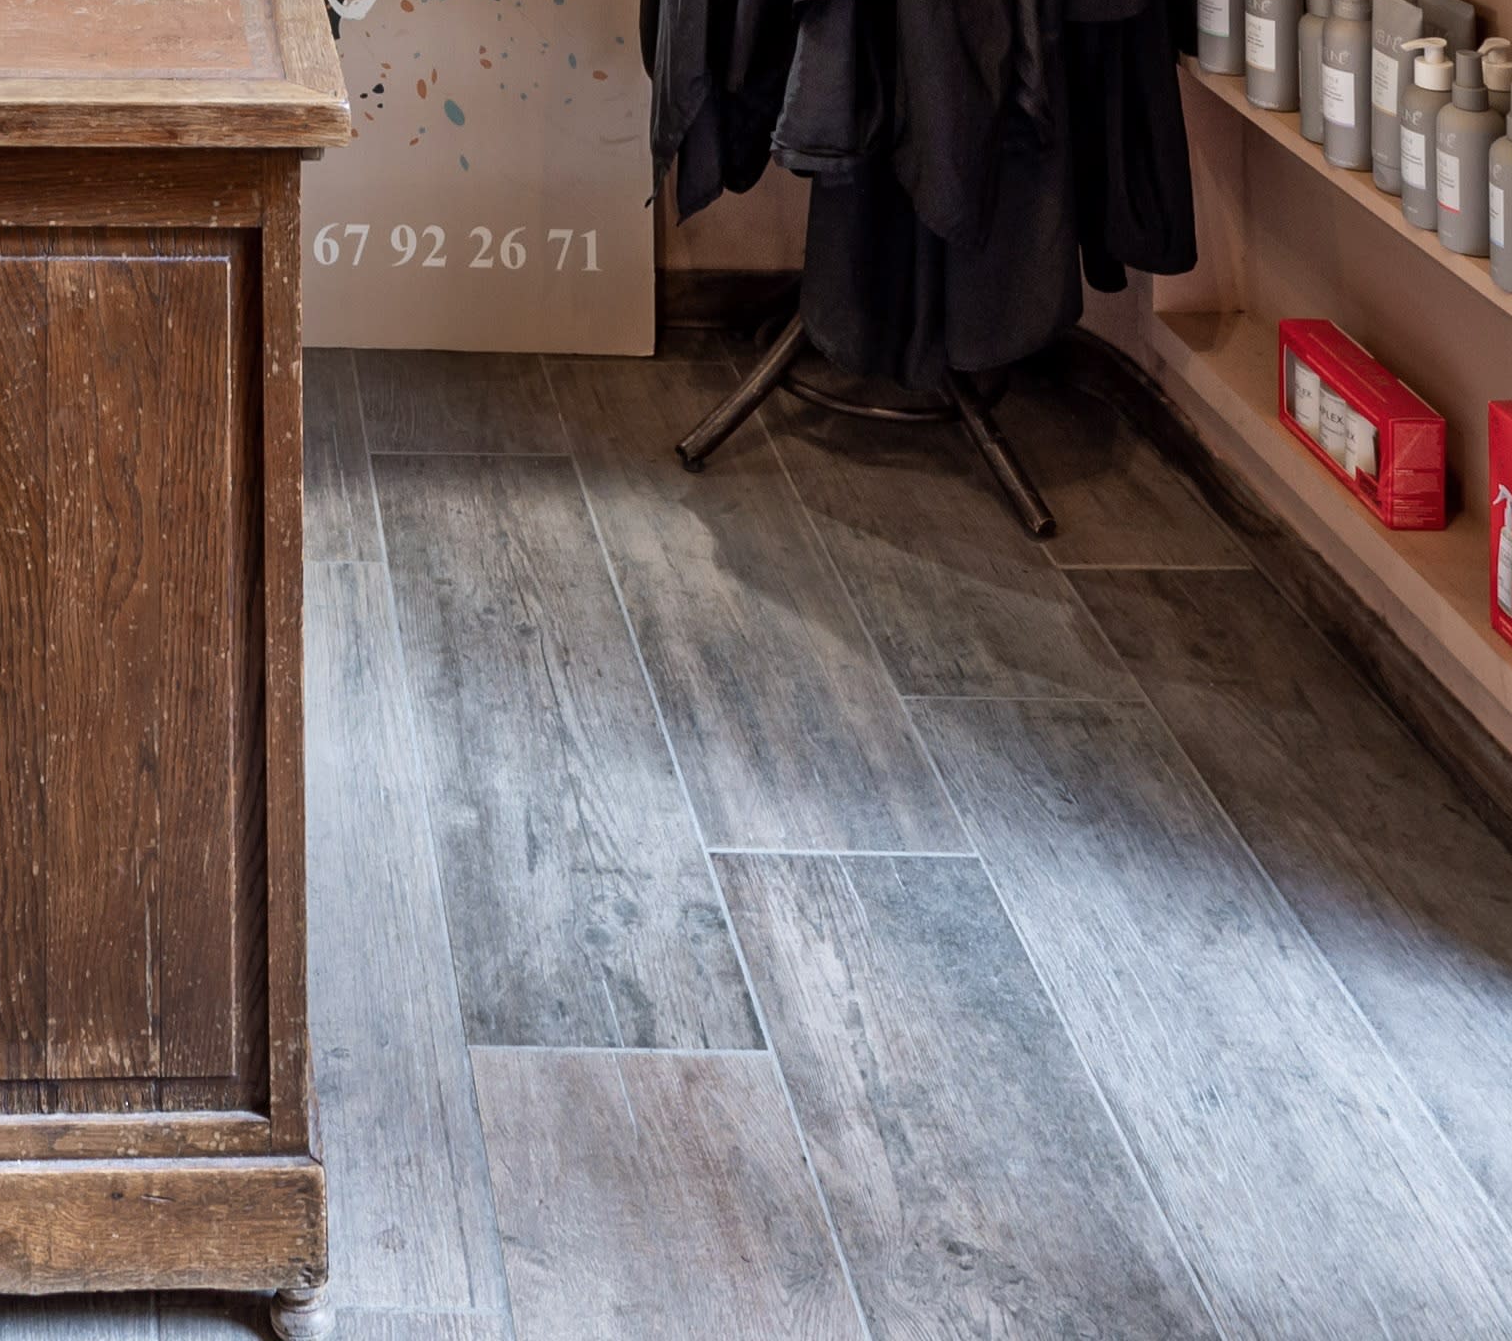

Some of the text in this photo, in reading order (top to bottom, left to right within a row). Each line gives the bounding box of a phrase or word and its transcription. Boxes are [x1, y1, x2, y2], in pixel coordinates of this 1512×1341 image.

[312, 222, 604, 273] 67 92 26 71
